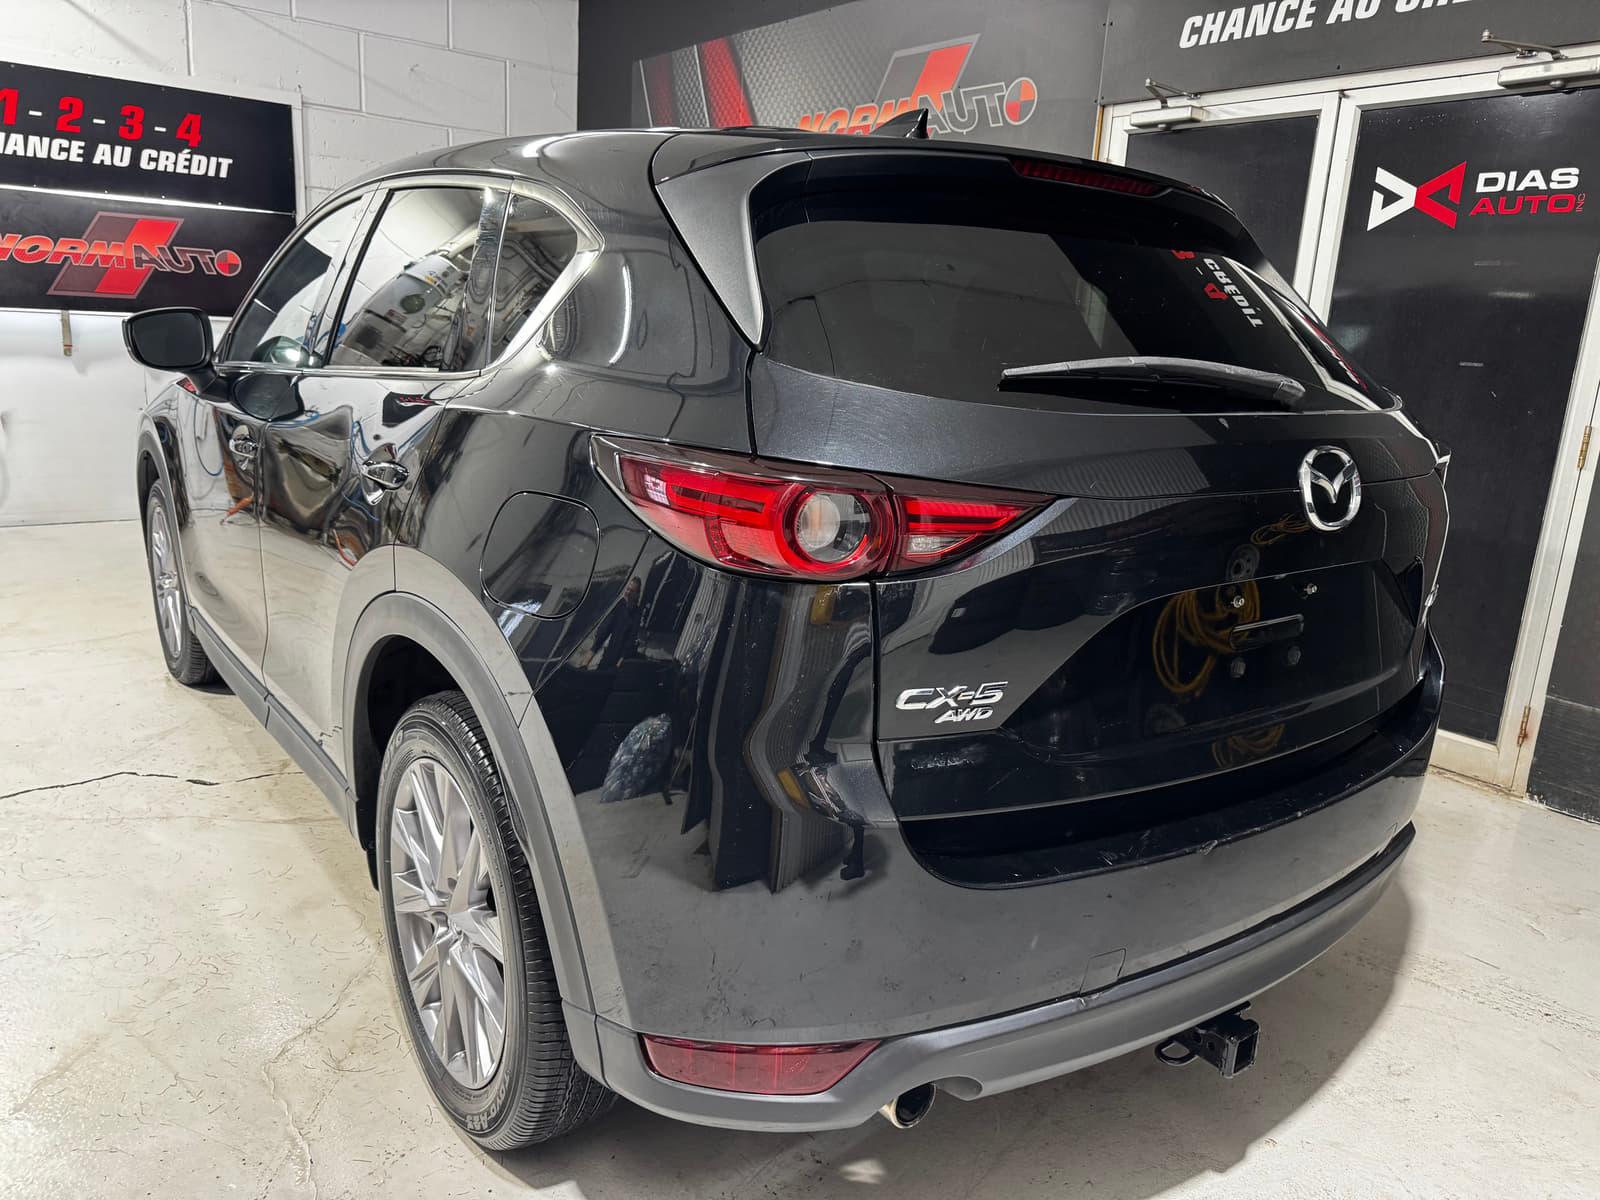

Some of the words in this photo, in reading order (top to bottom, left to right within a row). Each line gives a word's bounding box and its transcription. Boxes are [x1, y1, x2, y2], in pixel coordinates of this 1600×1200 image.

[1179, 0, 1317, 49] CHANCE
[0, 88, 19, 126] 1
[56, 96, 84, 133] 2
[118, 105, 145, 140] 3
[176, 113, 202, 148] 4
[92, 143, 133, 168] AU
[139, 148, 234, 179] CRÉDIT
[1475, 167, 1581, 194] DIAS
[1468, 193, 1577, 217] AUTO
[896, 680, 1009, 711] CX-5
[934, 706, 994, 724] AWD
